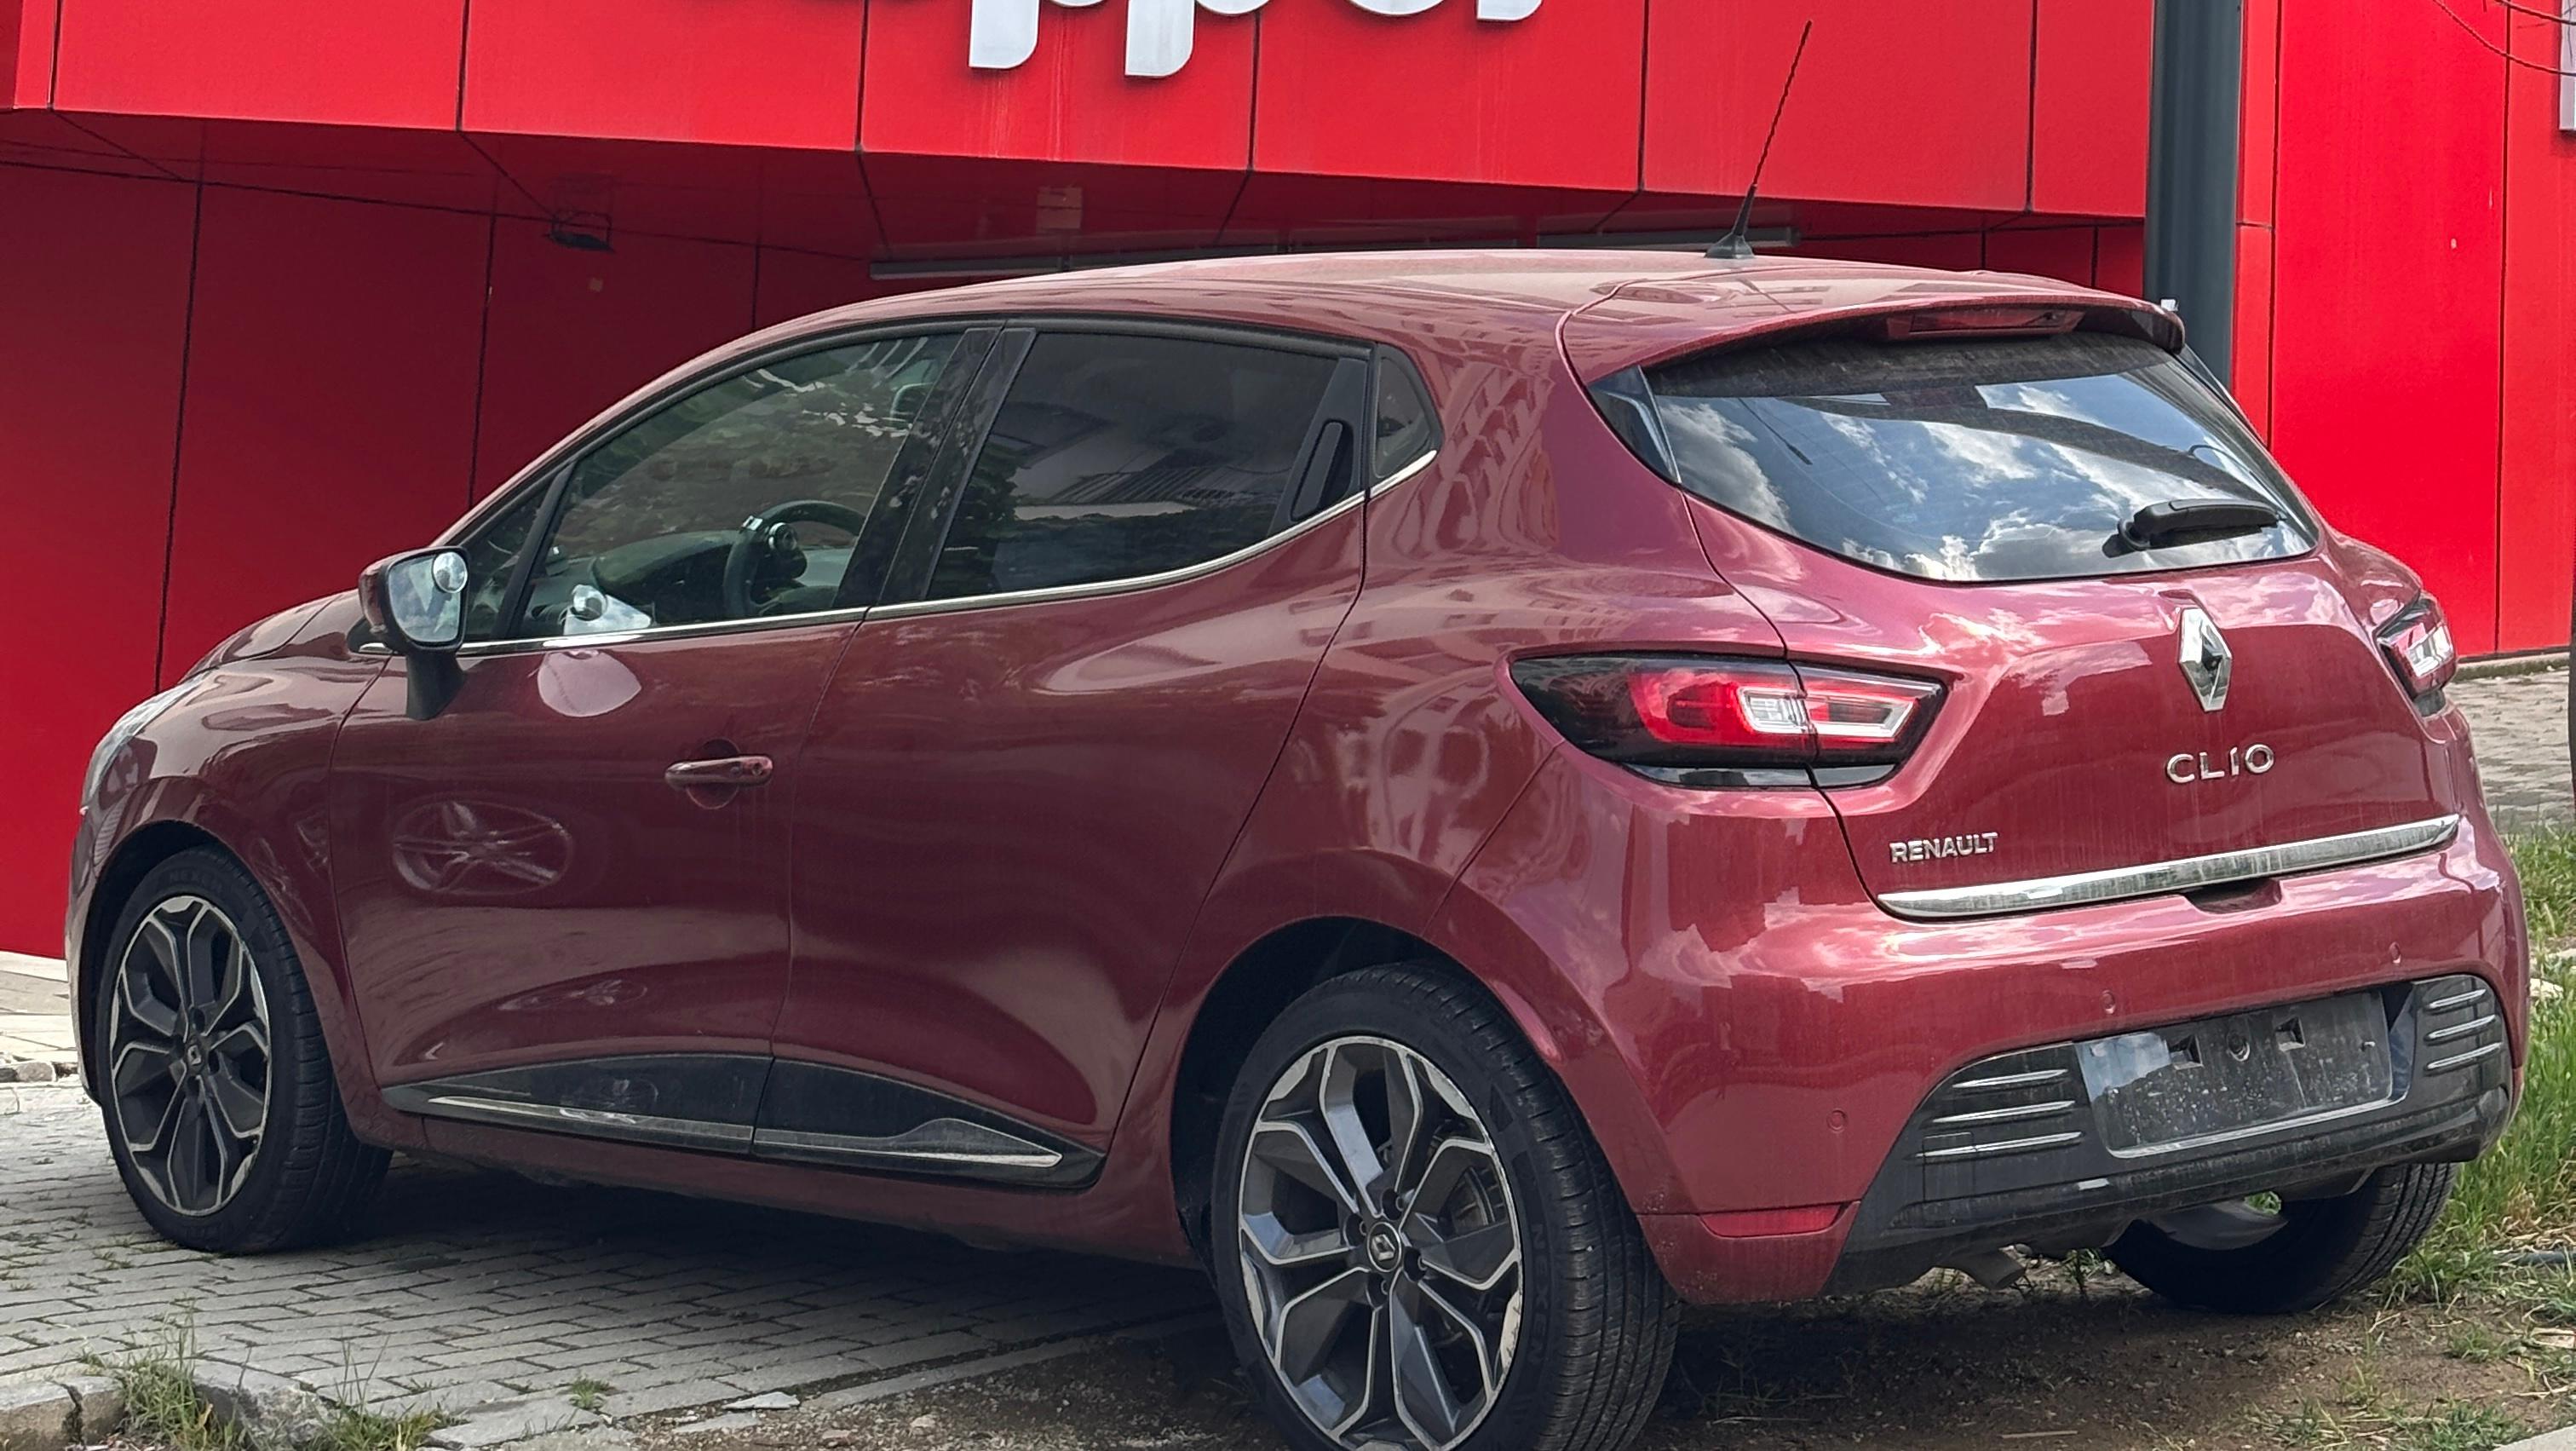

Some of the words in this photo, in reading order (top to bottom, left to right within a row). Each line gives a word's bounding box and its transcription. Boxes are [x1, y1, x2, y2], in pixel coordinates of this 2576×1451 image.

[2166, 743, 2275, 784] CLIO
[1889, 832, 1998, 863] RENAULT
[1527, 1223, 1550, 1365] NEXEN
